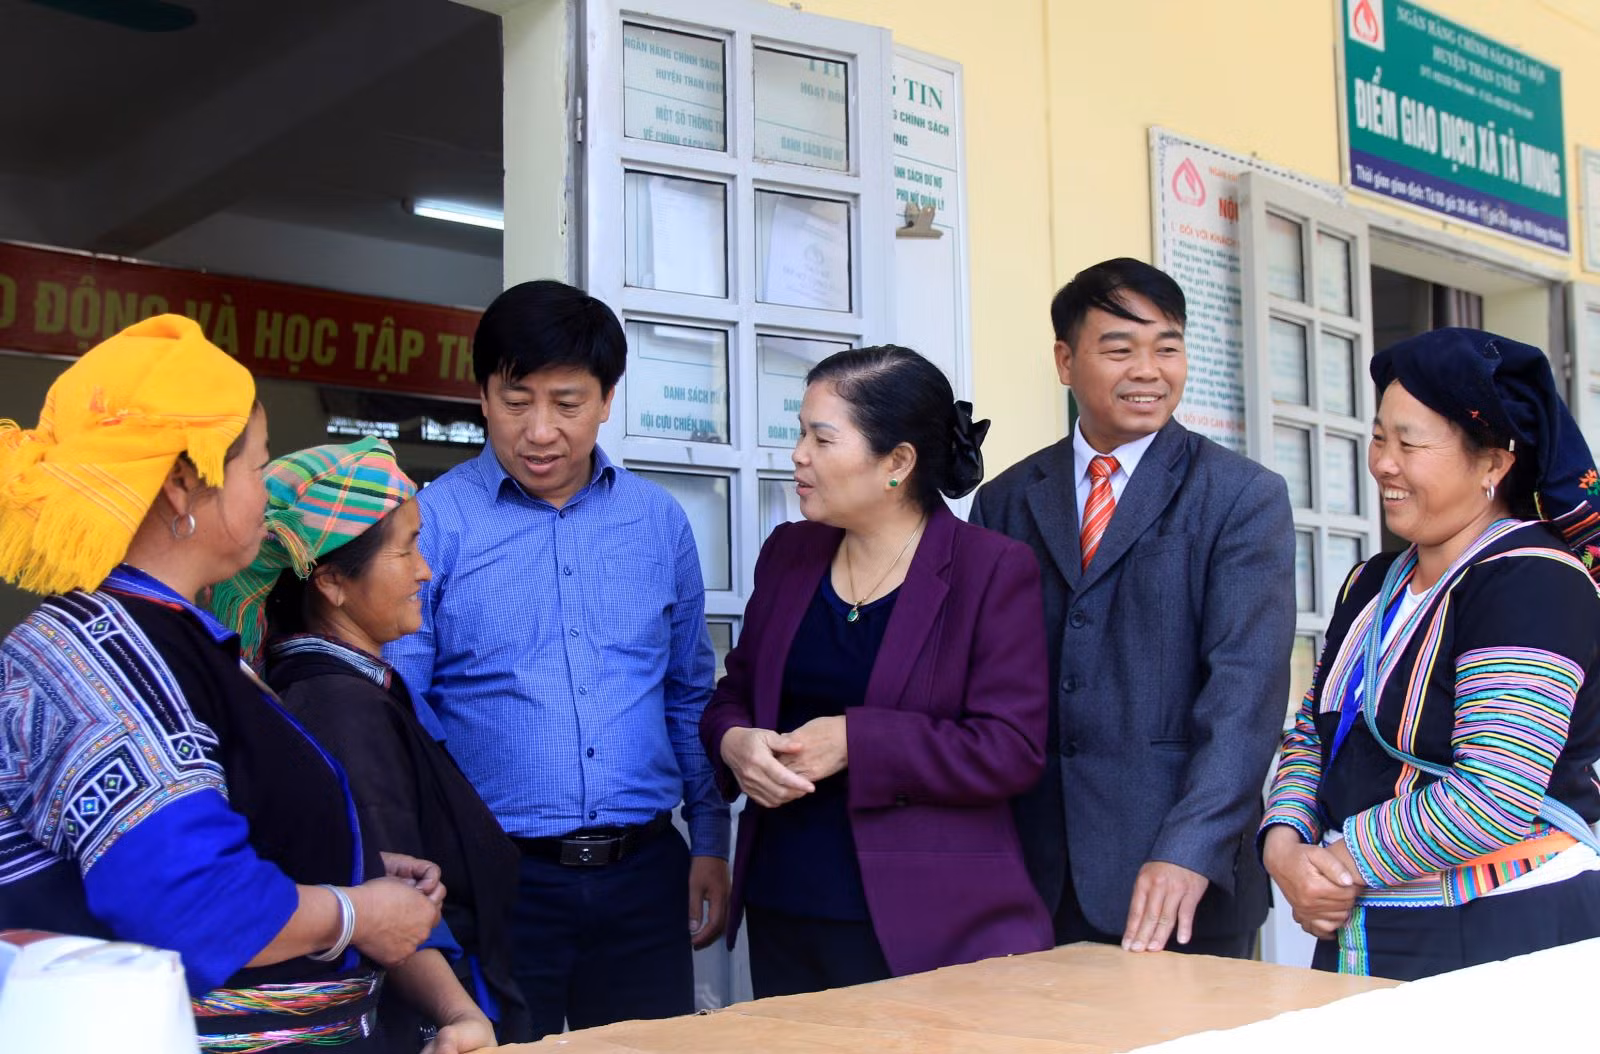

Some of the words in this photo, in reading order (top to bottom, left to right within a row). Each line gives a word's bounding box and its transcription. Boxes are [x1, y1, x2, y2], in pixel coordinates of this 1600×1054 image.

[649, 43, 672, 59] HÀNG
[673, 49, 698, 65] CHÍNH
[904, 77, 943, 111] TIN
[655, 105, 673, 125] MỘT
[675, 107, 686, 126] SỐ
[900, 110, 926, 128] CHÍNH
[927, 119, 950, 137] SÁCH
[1354, 65, 1398, 141] ĐIỂM
[1400, 95, 1438, 155] GIAO
[1440, 110, 1476, 173] DỊCH
[1477, 120, 1500, 177] XÃ
[1499, 128, 1520, 185] TÀ
[1519, 141, 1561, 198] MUNG
[254, 310, 339, 373] HỌC
[352, 316, 425, 382] TẬP
[437, 332, 476, 384] TH
[664, 385, 686, 401] DANH
[687, 385, 709, 404] SÁCH
[640, 410, 654, 431] HỘI
[656, 412, 672, 432] CỰU
[674, 412, 697, 431] CHIẾN
